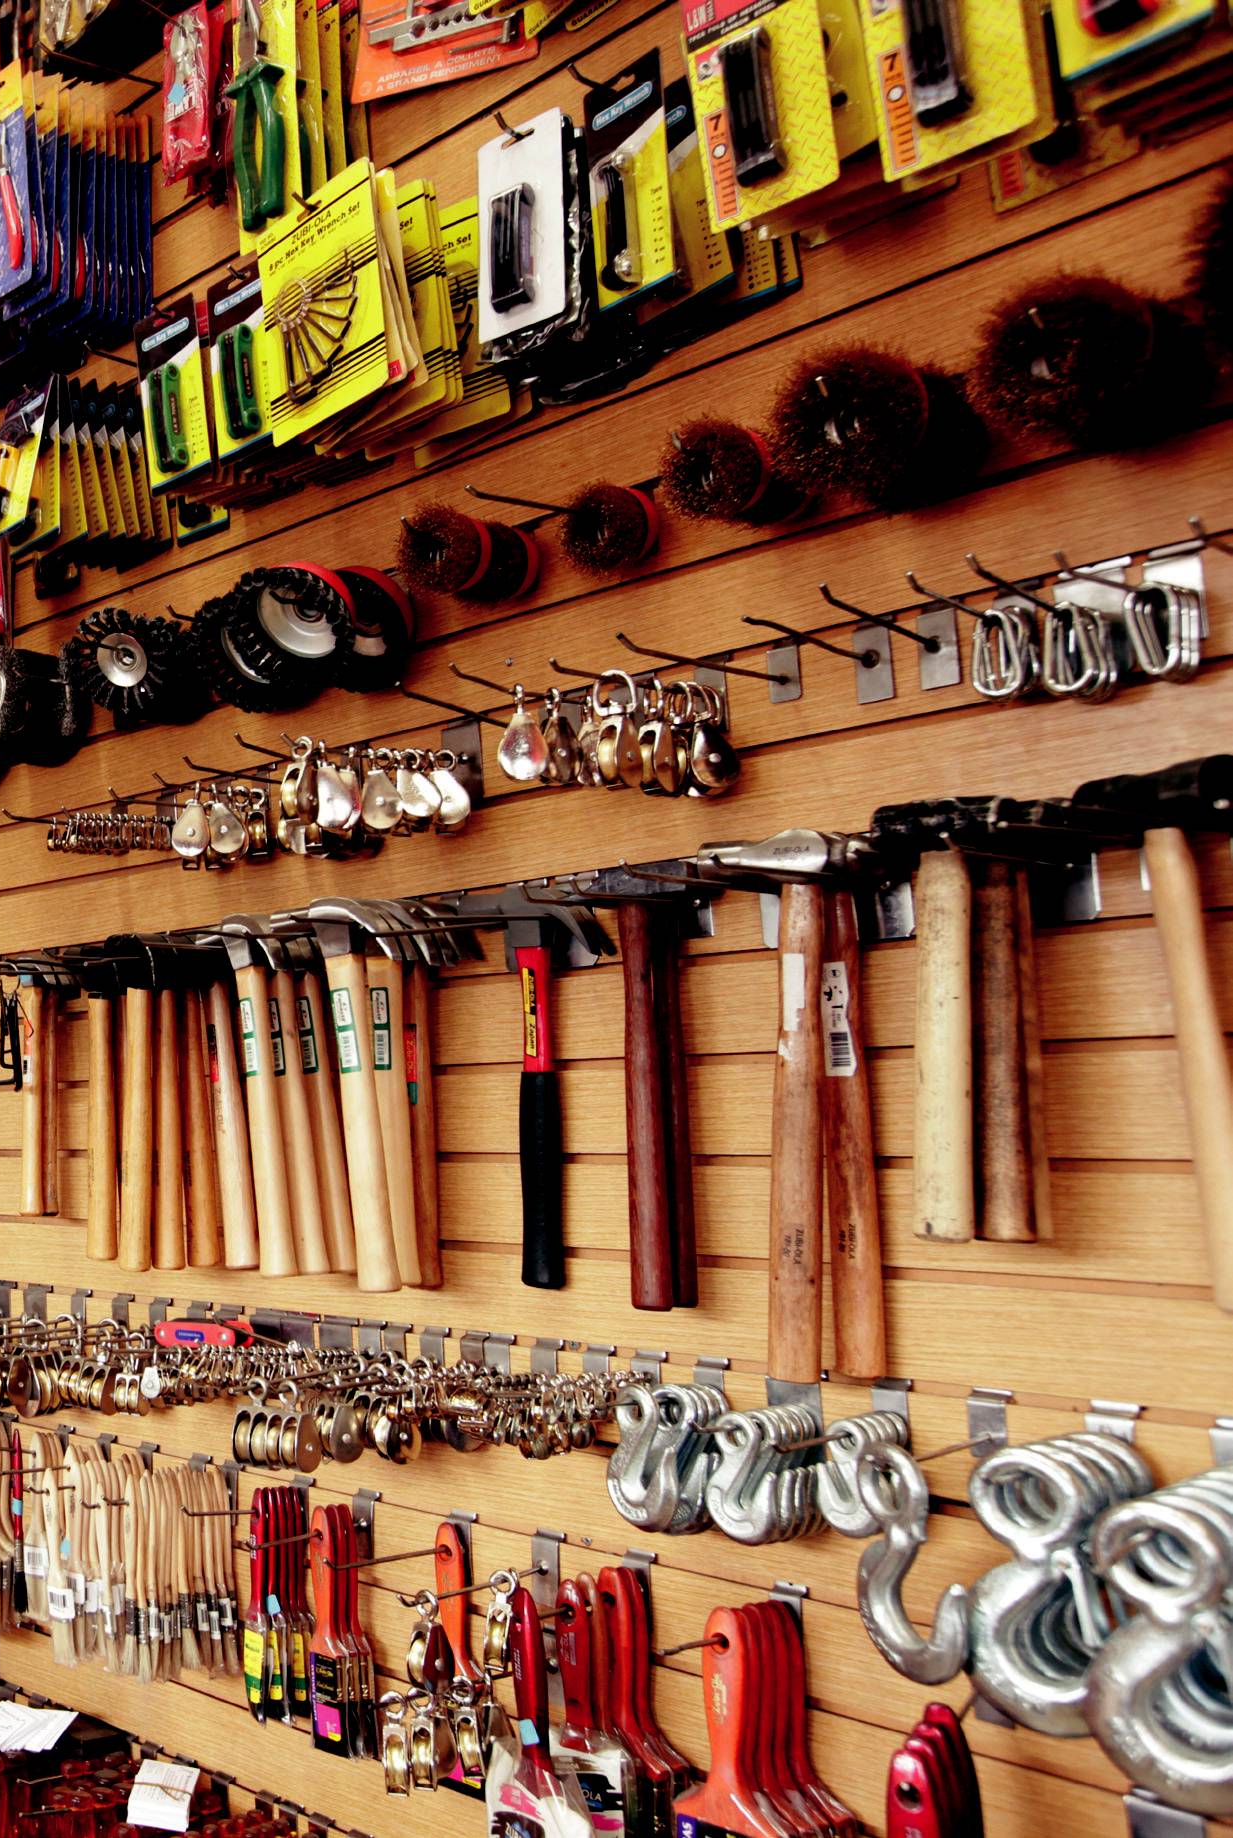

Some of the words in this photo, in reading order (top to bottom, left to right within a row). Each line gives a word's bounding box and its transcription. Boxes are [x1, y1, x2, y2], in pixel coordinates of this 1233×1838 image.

[884, 52, 898, 71] 7
[709, 114, 722, 131] 7
[285, 247, 299, 260] Hex
[300, 235, 315, 248] Key
[317, 212, 347, 237] Wrench
[347, 202, 361, 217] Set
[290, 209, 332, 244] ZUBI-OLA
[399, 216, 414, 231] Set
[456, 233, 472, 248] Set
